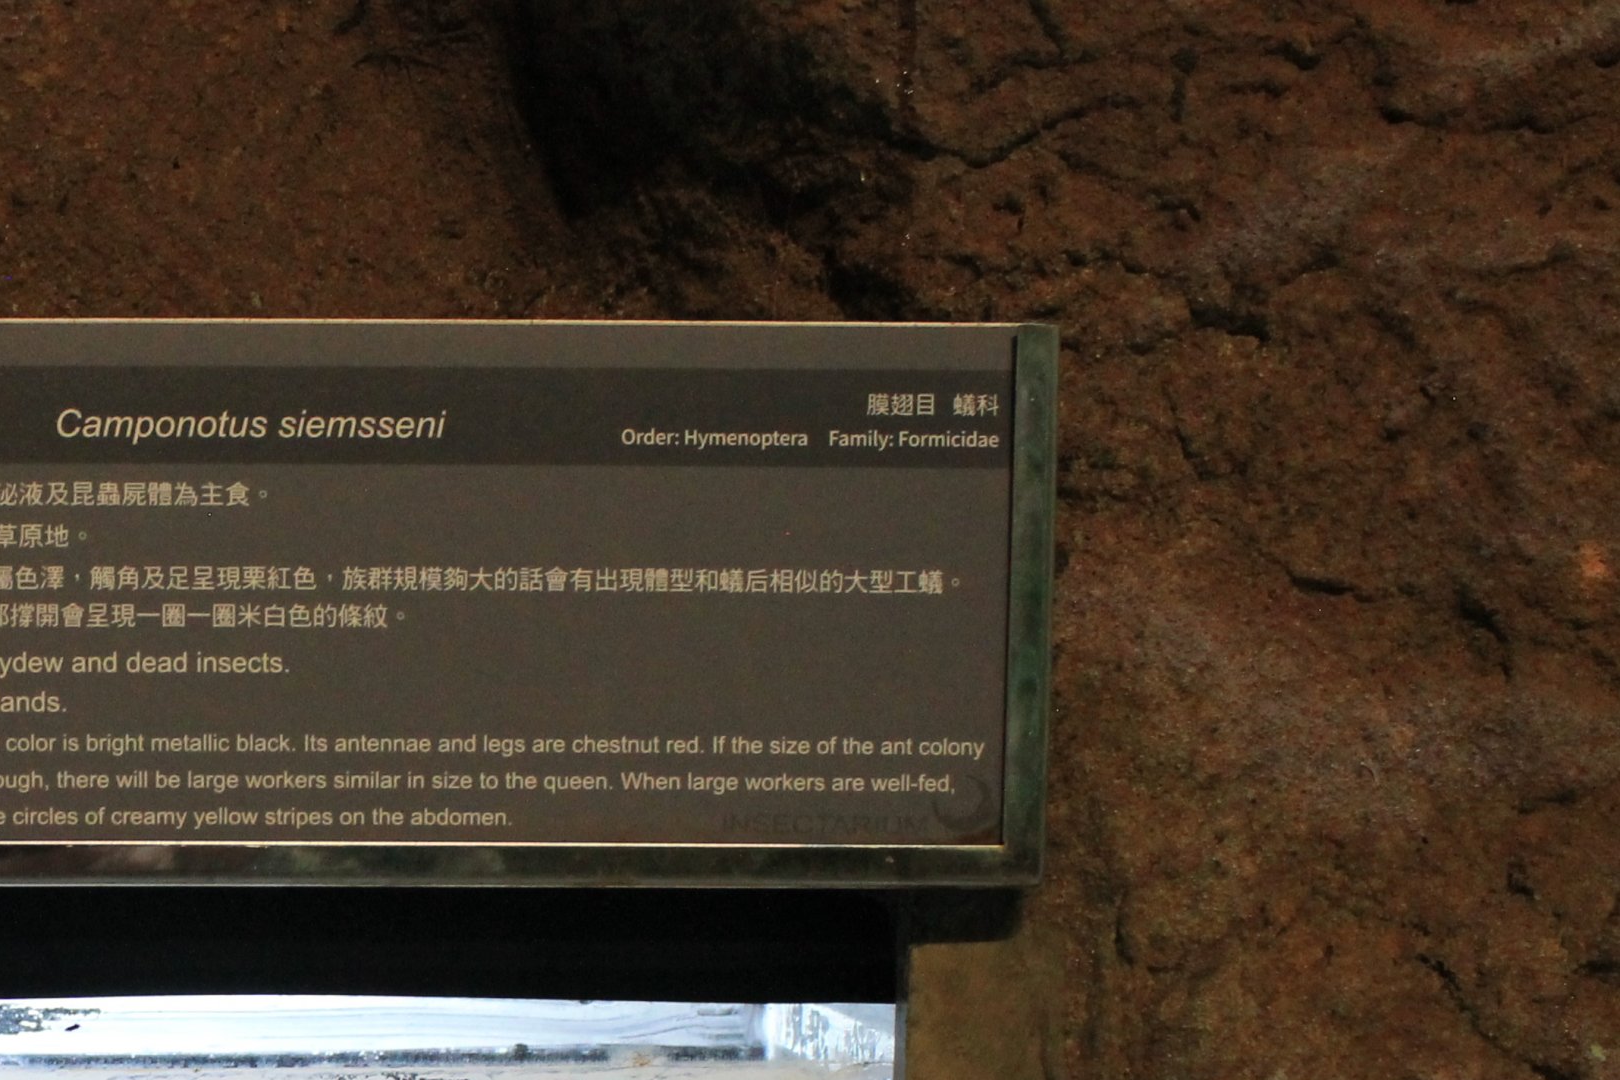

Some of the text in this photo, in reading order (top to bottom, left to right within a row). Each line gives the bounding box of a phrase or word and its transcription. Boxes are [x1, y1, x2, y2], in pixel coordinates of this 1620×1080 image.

[866, 392, 1000, 417] 膜翅目 蟻科
[55, 407, 447, 446] Camponotus siemsseni
[620, 427, 1000, 452] Order: Hymenoptera Family: Formicidae
[71, 650, 118, 674] and
[125, 650, 188, 674] dead
[196, 650, 290, 674] insects.
[5, 733, 57, 753] color
[62, 733, 80, 752] is
[85, 733, 145, 757] bright
[150, 733, 230, 753] metallic
[236, 733, 296, 753] black.
[304, 733, 329, 753] Its
[334, 734, 432, 753] antennae
[437, 733, 477, 753] and
[483, 734, 526, 758] legs
[531, 738, 566, 754] are
[571, 734, 660, 754] chestnut
[666, 735, 705, 754] red.
[712, 735, 727, 754] If
[730, 735, 764, 755] the
[769, 736, 811, 755] size
[816, 735, 838, 755] of
[842, 736, 875, 756] the
[880, 738, 913, 756] ant
[918, 737, 985, 761] colony
[56, 770, 110, 790] there
[115, 769, 149, 789] will
[154, 770, 181, 789] be
[187, 770, 240, 794] large
[244, 770, 328, 789] workers
[333, 770, 402, 790] similar
[407, 771, 425, 789] in
[431, 771, 473, 790] size
[479, 772, 499, 790] to
[504, 771, 538, 790] the
[543, 775, 613, 794] queen.
[620, 771, 682, 791] When
[687, 772, 739, 796] large
[744, 772, 826, 792] workers
[831, 777, 866, 792] are
[870, 773, 955, 795] well-fed,
[12, 806, 79, 826] circles
[84, 806, 106, 826] of
[110, 810, 188, 830] creamy
[193, 806, 259, 830] yellow
[264, 807, 334, 830] stripes
[339, 811, 365, 826] on
[371, 807, 405, 826] the
[410, 807, 512, 826] abdomen.
[723, 814, 929, 835] INSECTARIUM
